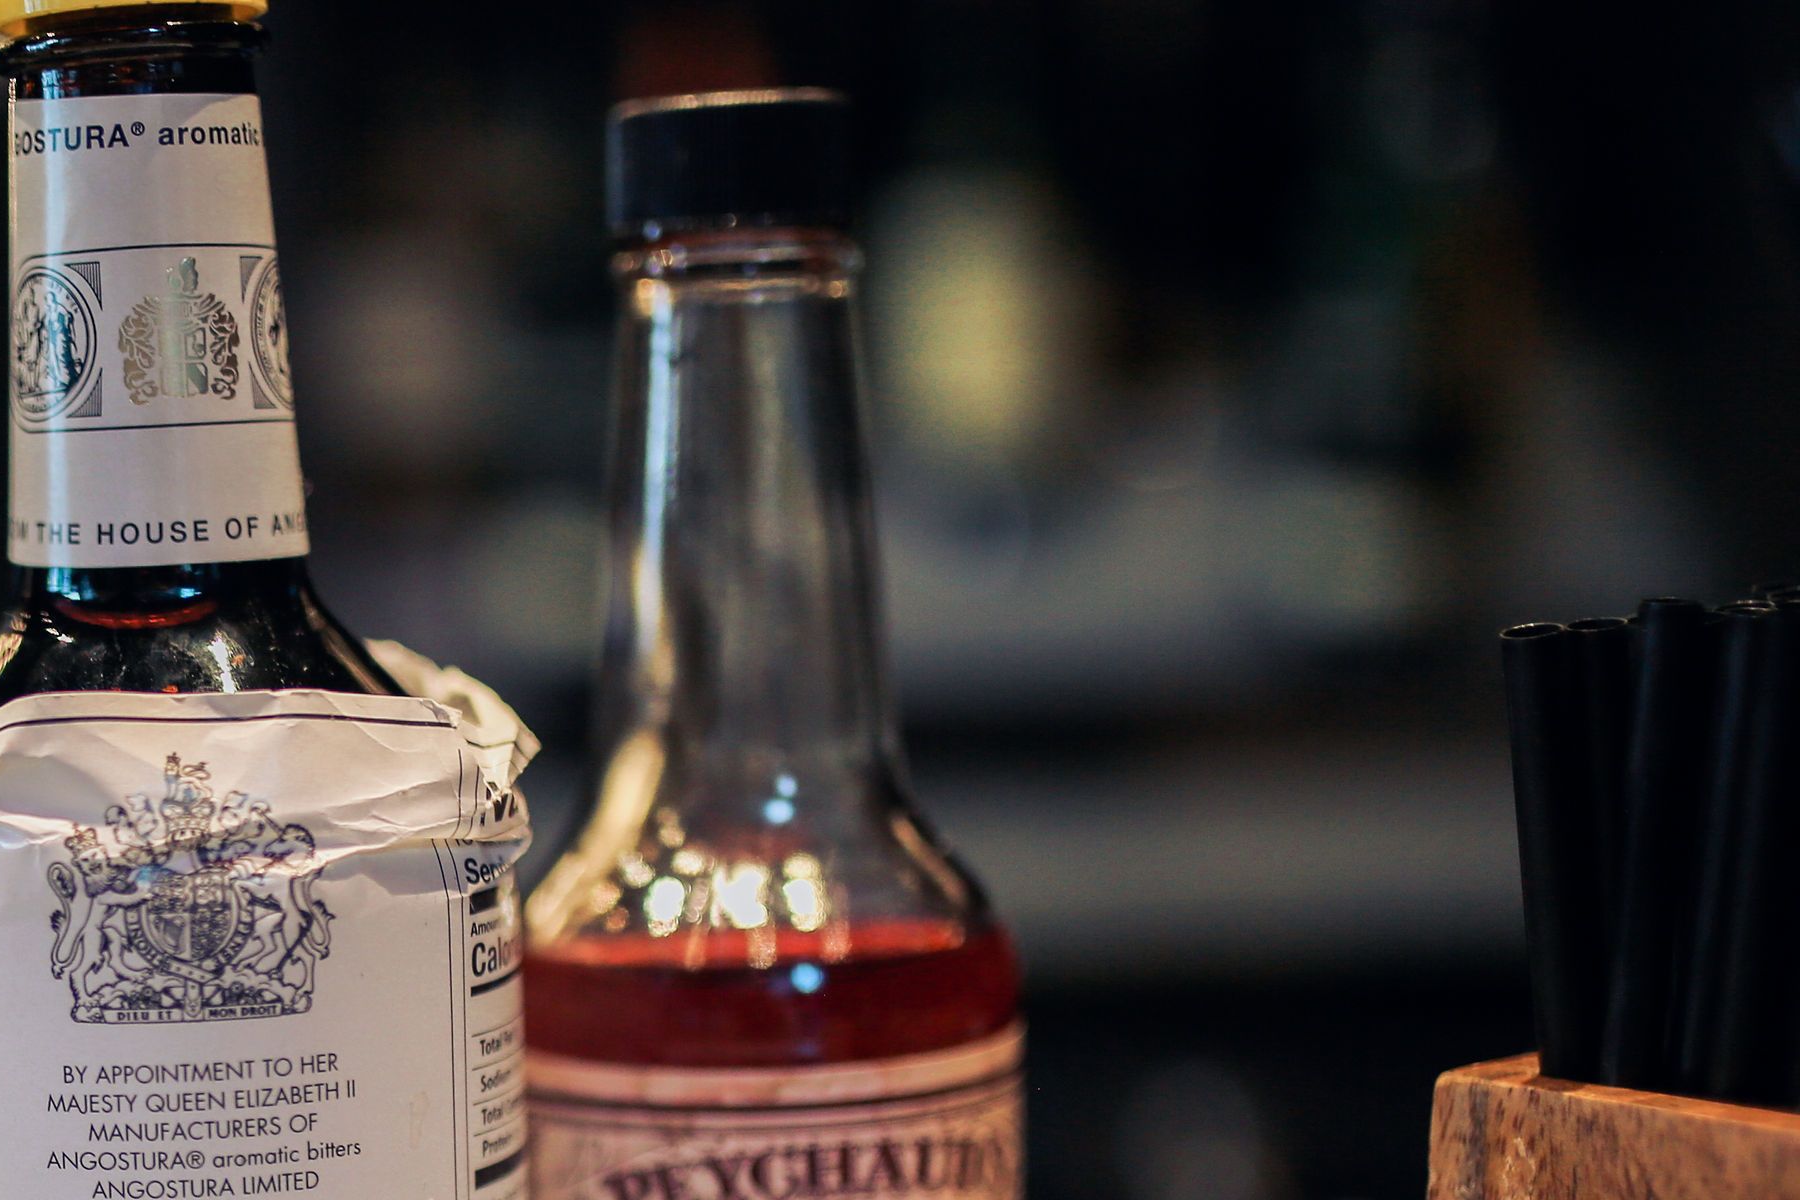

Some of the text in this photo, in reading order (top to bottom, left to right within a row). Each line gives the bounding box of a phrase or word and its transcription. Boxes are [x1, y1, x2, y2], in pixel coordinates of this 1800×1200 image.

[158, 122, 259, 147] aromatic
[36, 522, 81, 545] THE
[97, 519, 209, 545] HOUSE
[225, 516, 258, 539] OF
[117, 1004, 277, 1022] DIEU ET MON DROIT
[63, 1052, 339, 1085] BY APPOINTMENT TO HER
[47, 1093, 137, 1115] MAJESTY
[145, 1091, 226, 1114] QUEEN
[234, 1082, 340, 1110] ELIZABETH
[88, 1113, 318, 1142] MANUFACTURERS OF
[46, 1141, 362, 1171] ANGOSTURA® aromatic bitters
[92, 1171, 320, 1200] ANGOSTURA LIMITED
